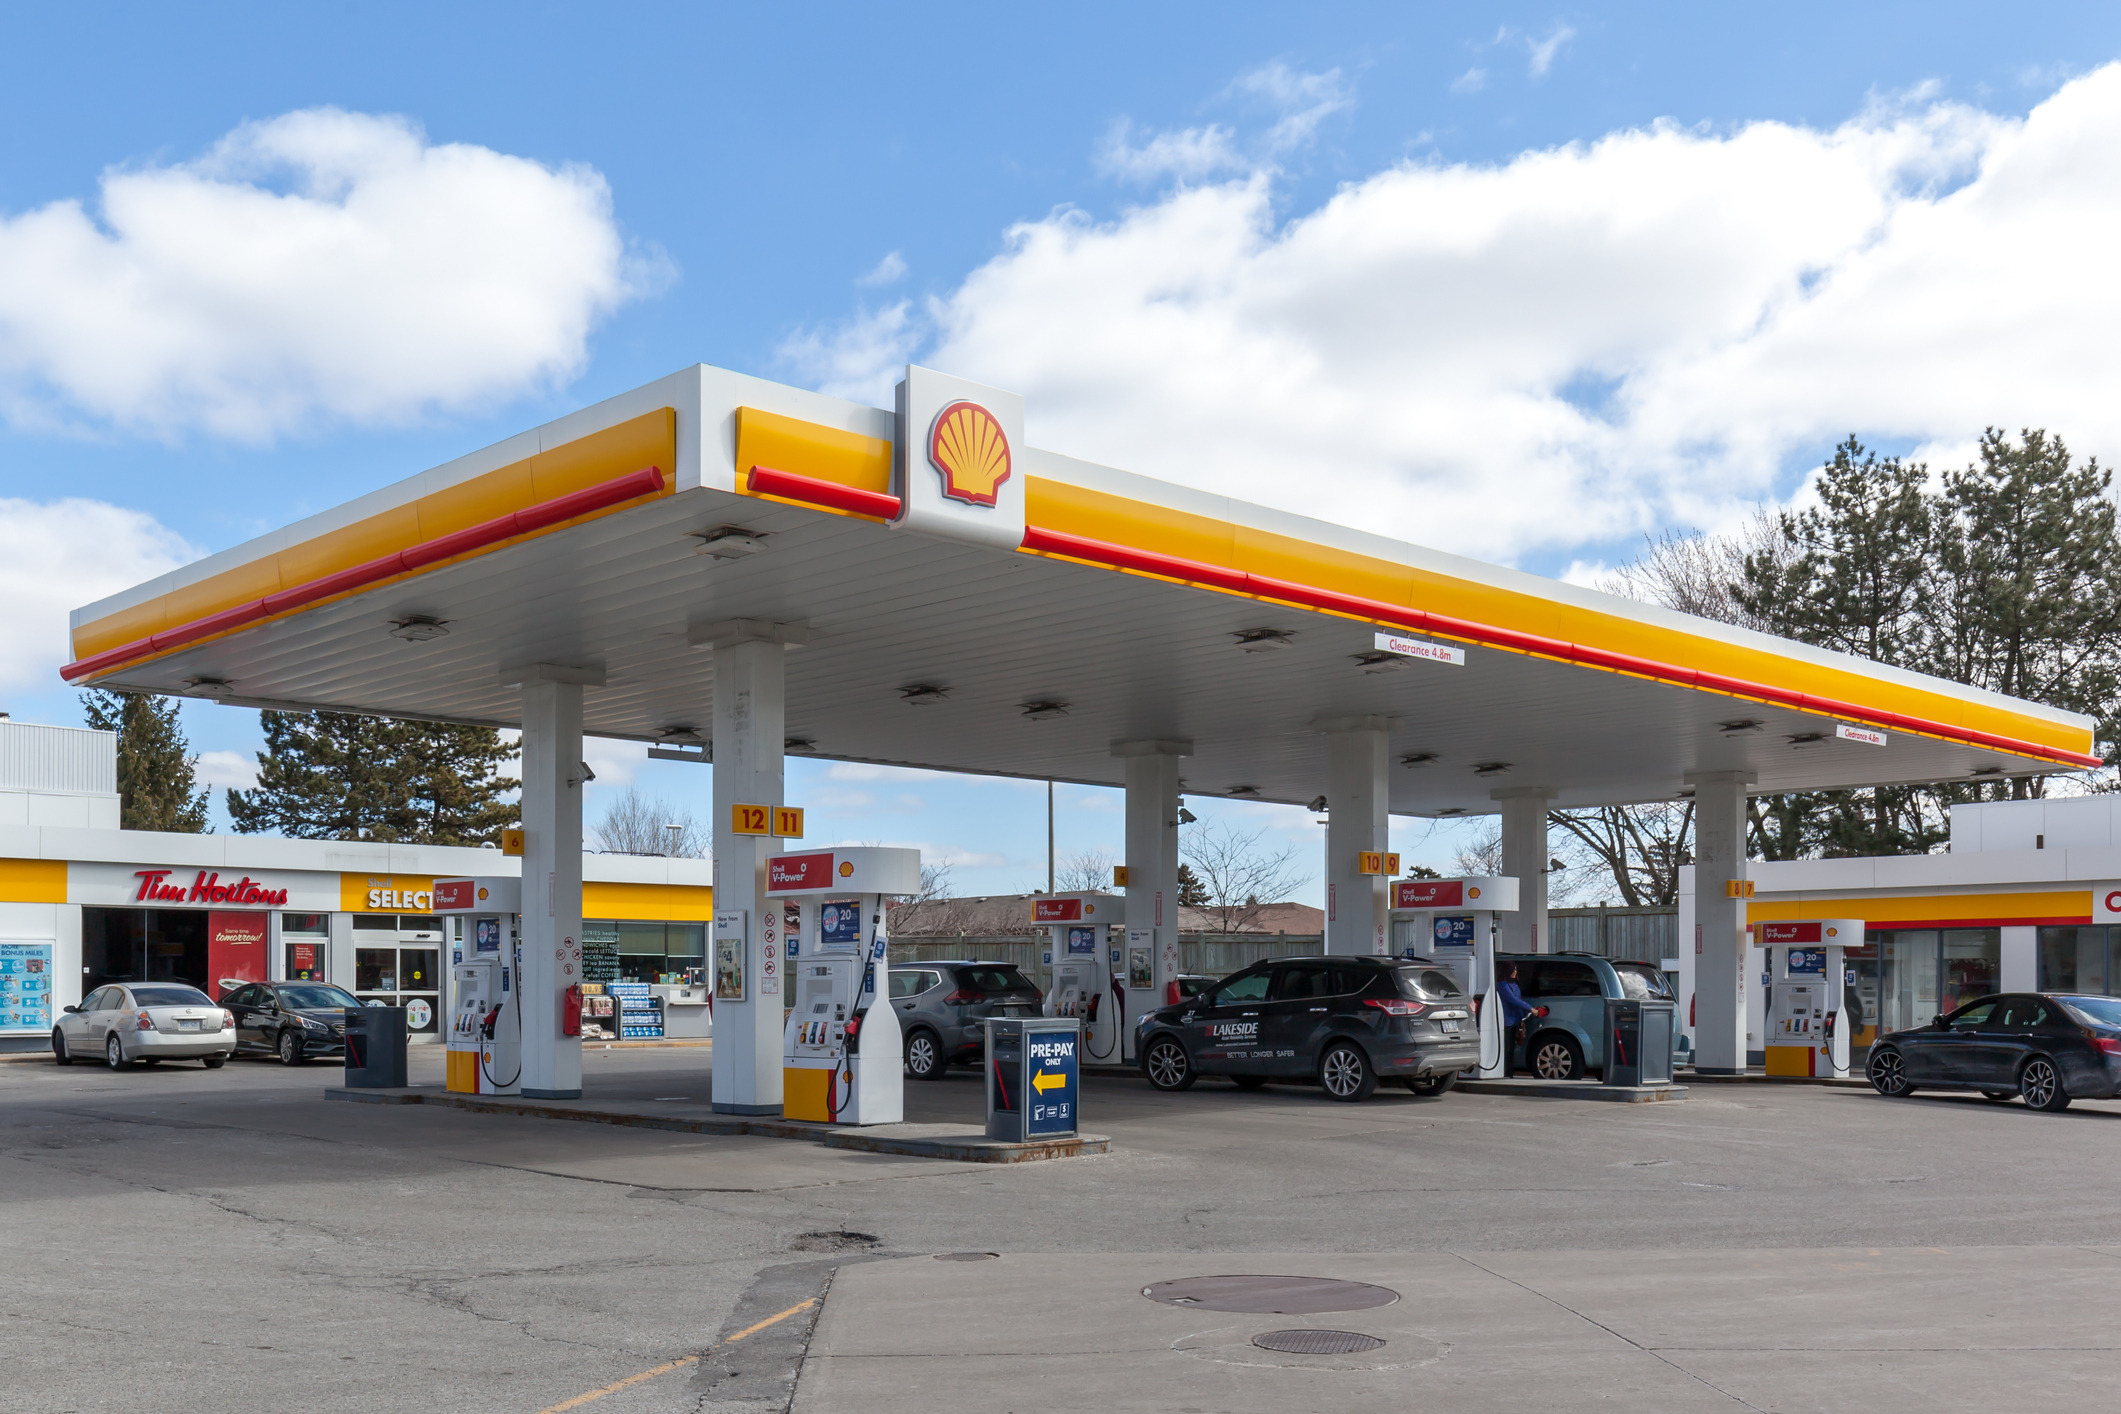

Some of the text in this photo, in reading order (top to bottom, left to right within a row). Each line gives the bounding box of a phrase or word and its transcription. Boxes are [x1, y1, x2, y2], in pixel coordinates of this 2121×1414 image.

[1389, 639, 1452, 661] Clearance 4.8m
[1844, 728, 1880, 743] Clearance 4.8m
[742, 809, 764, 830] 12
[782, 812, 797, 832] 11
[512, 837, 519, 848] 6
[773, 865, 784, 873] Shell
[1367, 856, 1380, 870] 10
[1389, 857, 1396, 871] 9
[367, 878, 392, 888] Shell
[773, 873, 804, 882] V-Power
[134, 870, 288, 906] Tim Hortons
[1734, 882, 1740, 896] 8
[1747, 884, 1752, 896] 7
[368, 889, 433, 909] SELECT
[840, 909, 852, 920] 20
[488, 925, 496, 934] 20
[1453, 922, 1464, 930] 20
[215, 932, 263, 942] tomorrow!
[1213, 1022, 1258, 1036] LAKESIDE
[1031, 1042, 1074, 1058] PRE-PAY
[1045, 1058, 1061, 1066] ONLY
